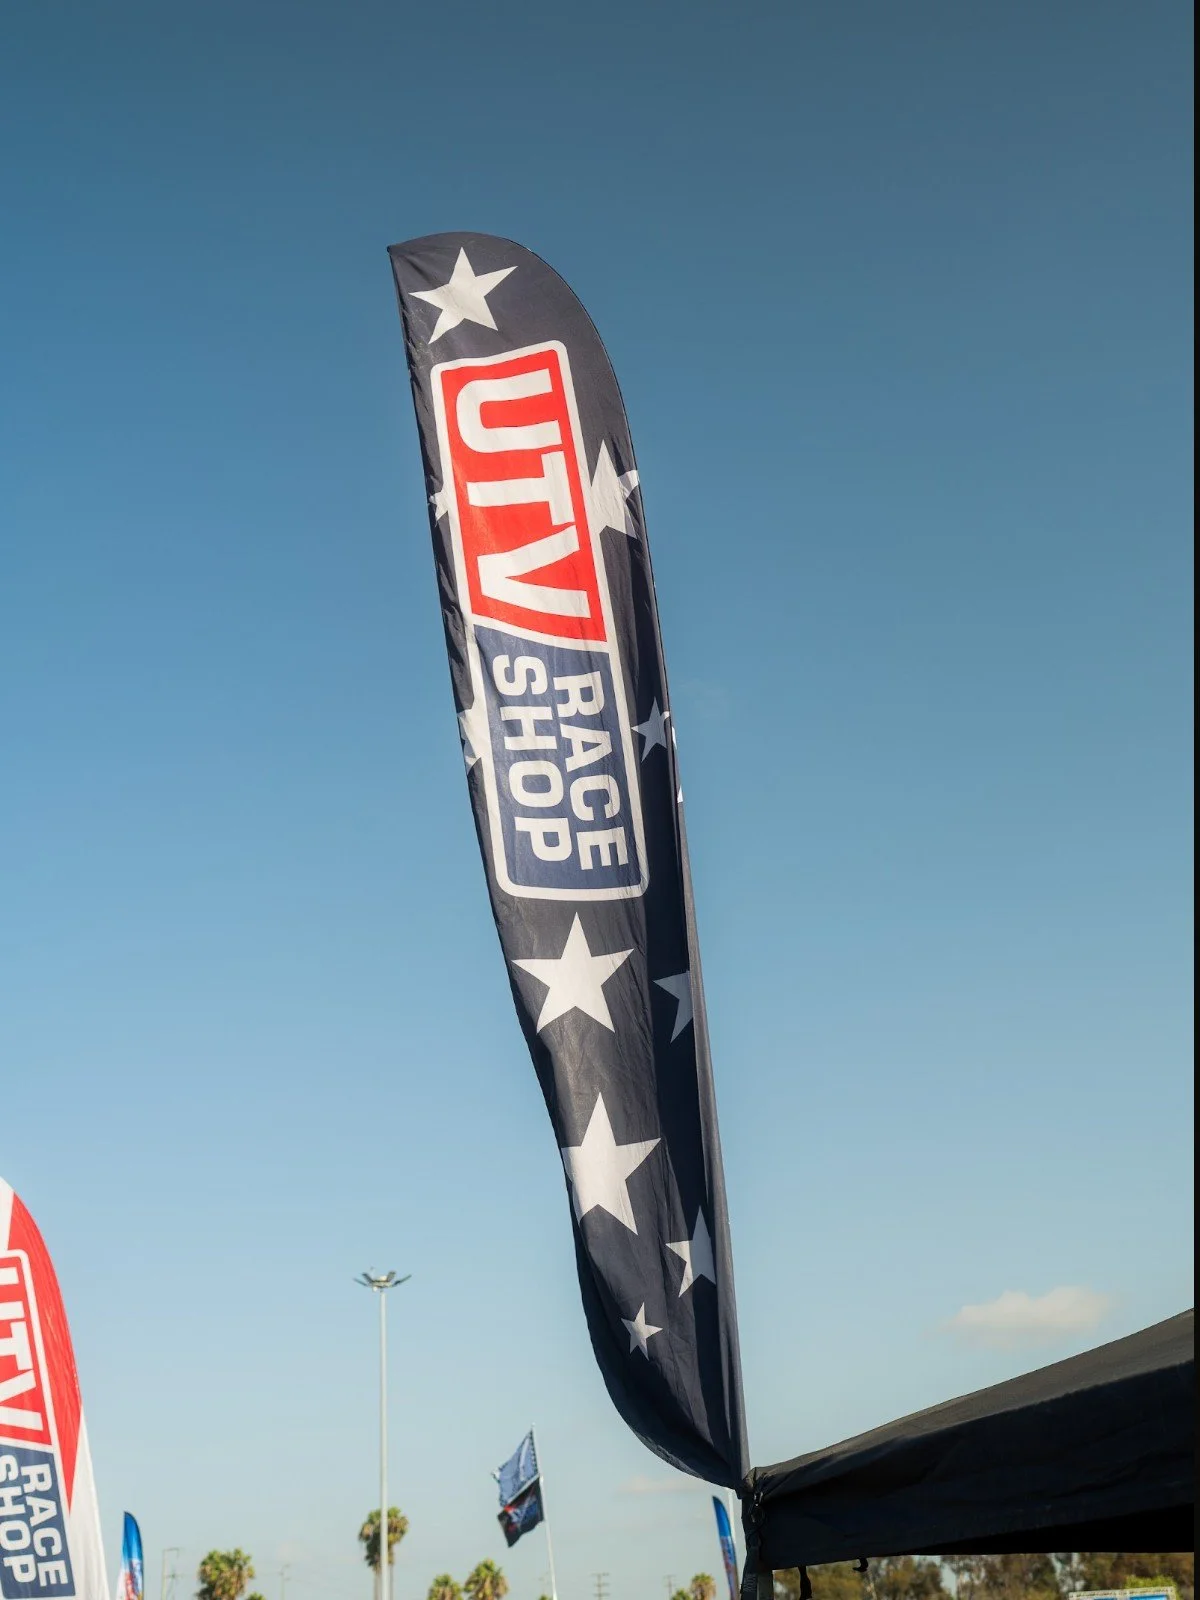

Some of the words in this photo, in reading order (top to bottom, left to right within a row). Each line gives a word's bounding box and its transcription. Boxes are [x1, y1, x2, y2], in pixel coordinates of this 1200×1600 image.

[455, 368, 590, 618] UTV
[492, 655, 573, 864] SHOP
[553, 671, 628, 870] RACE
[0, 1454, 37, 1583] SHOP
[21, 1463, 68, 1587] RACE
